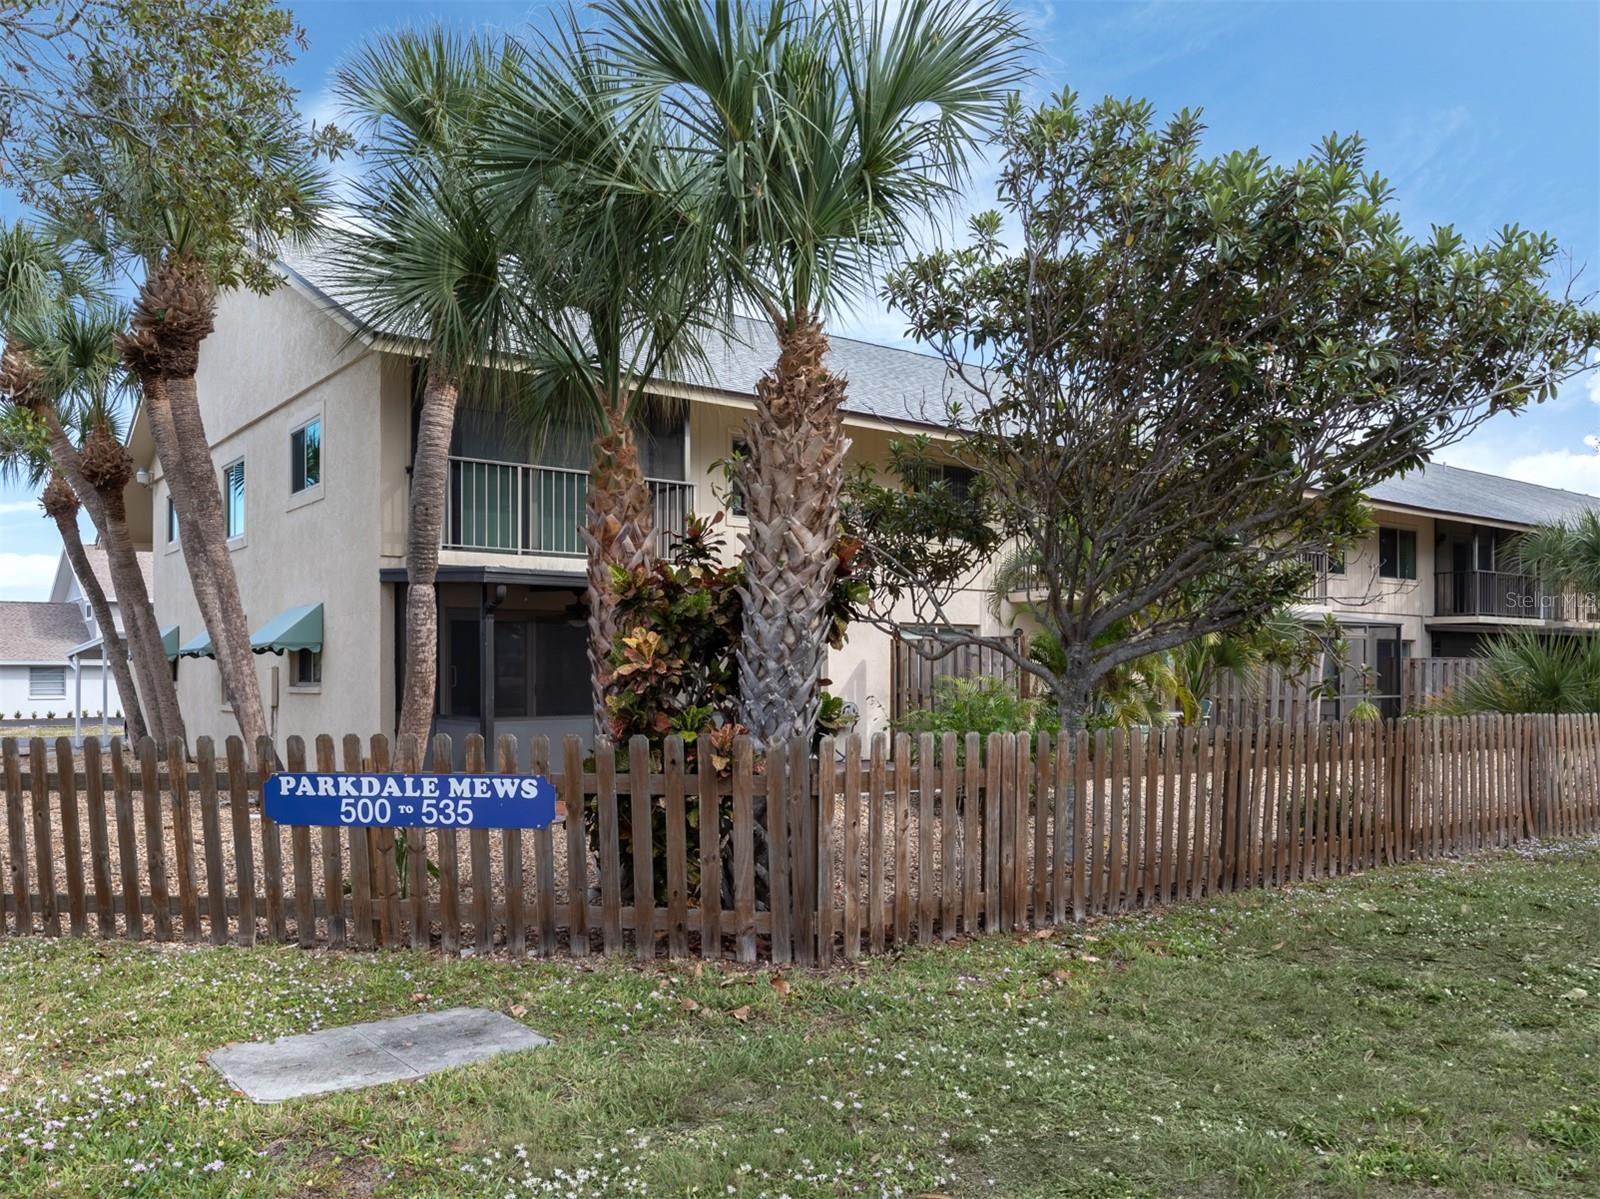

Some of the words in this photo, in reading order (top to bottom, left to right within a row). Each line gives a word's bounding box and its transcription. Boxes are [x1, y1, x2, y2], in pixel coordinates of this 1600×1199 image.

[278, 776, 440, 797] PARKDALE
[448, 778, 539, 799] MEWS
[339, 798, 391, 824] 500
[398, 805, 414, 814] TO
[421, 799, 474, 825] 535
